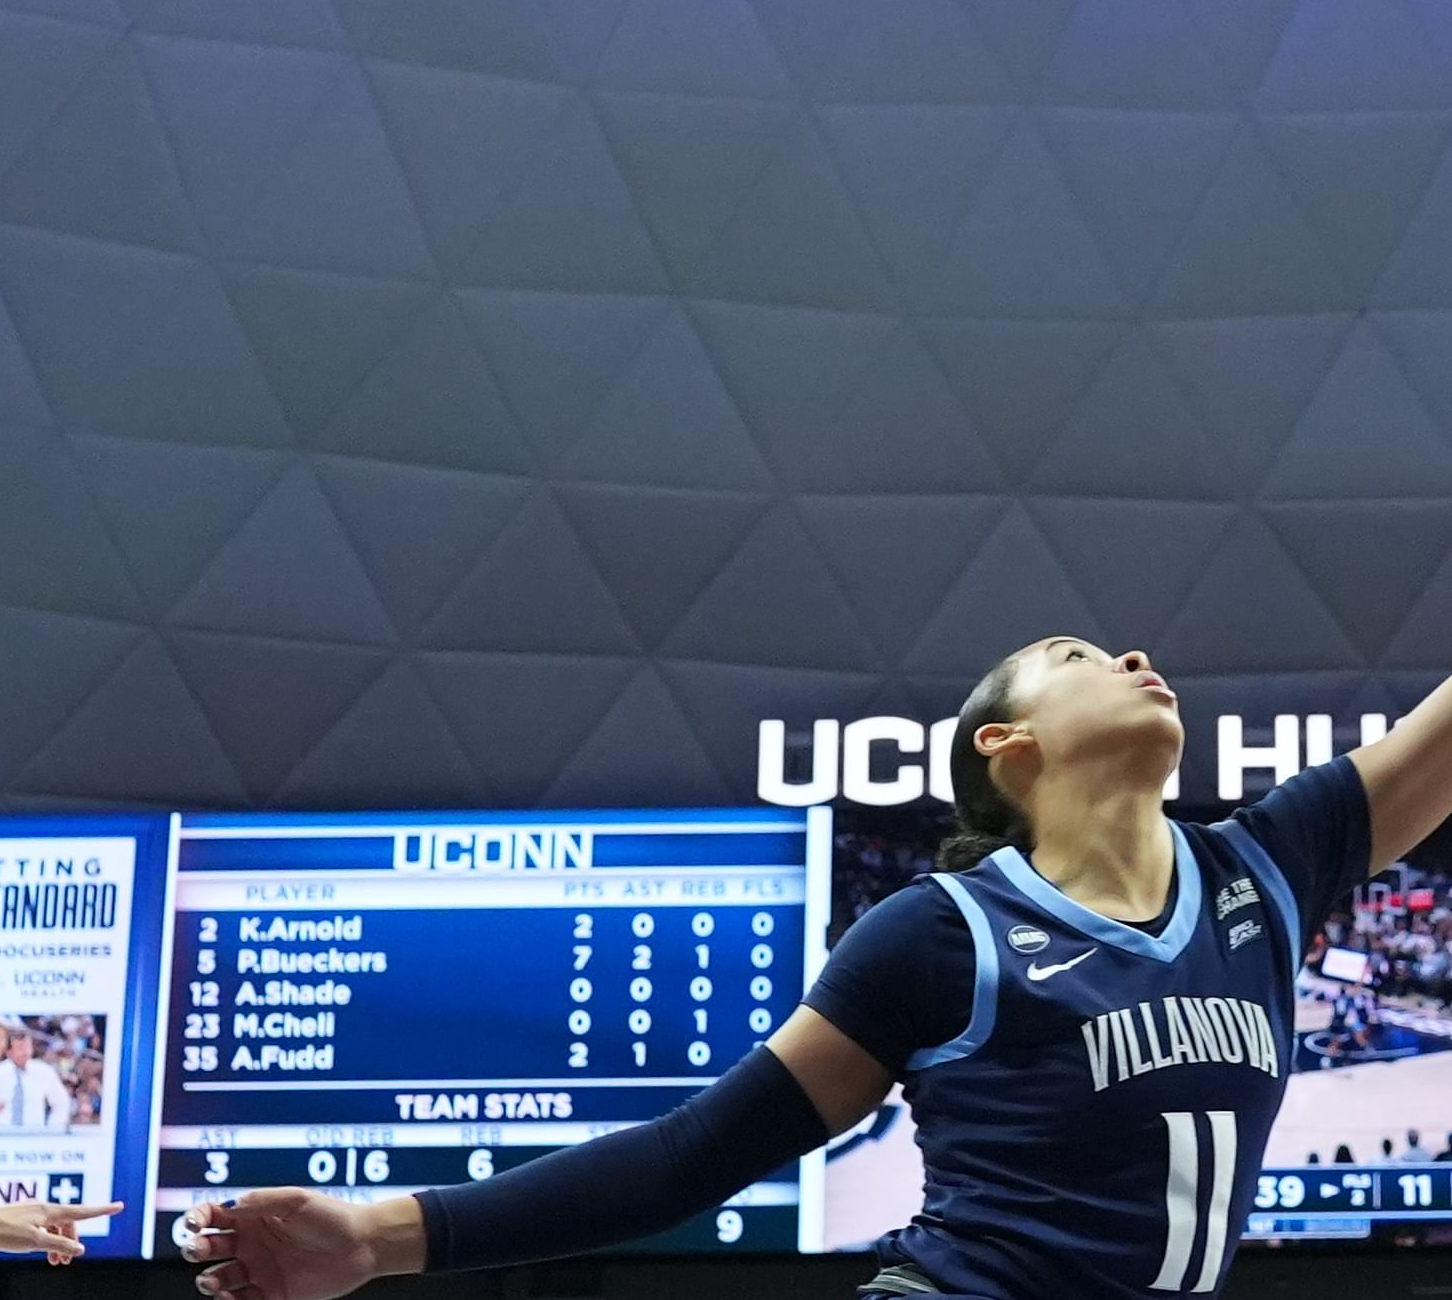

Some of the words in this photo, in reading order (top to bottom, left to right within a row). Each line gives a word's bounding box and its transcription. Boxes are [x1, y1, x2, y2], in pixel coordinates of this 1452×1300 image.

[392, 830, 595, 871] UCONN
[246, 883, 336, 902] PLAYER
[564, 879, 604, 897] PTS
[623, 879, 666, 897] AST
[681, 878, 727, 895] REB
[743, 877, 784, 894] FLS
[198, 917, 219, 943] 2
[238, 915, 363, 942] K.Arnold
[573, 913, 594, 939] 2
[631, 912, 655, 938] 0
[691, 912, 715, 937] 0
[751, 911, 775, 937] 0
[197, 949, 216, 974] 5
[237, 948, 388, 974] P.Bueckers
[572, 945, 593, 971] 7
[631, 944, 653, 970] 2
[694, 944, 710, 969] 1
[750, 943, 774, 969] 0
[14, 970, 85, 986] UCONN
[189, 981, 220, 1007] 12
[234, 980, 352, 1006] A.Shade
[569, 977, 593, 1003] 0
[629, 977, 653, 1002] 0
[689, 976, 713, 1001] 0
[749, 975, 773, 1001] 0
[184, 1013, 221, 1039] 23
[568, 1009, 592, 1035] 0
[628, 1009, 652, 1034] 0
[692, 1008, 708, 1034] 1
[748, 1007, 773, 1033] 0
[183, 1046, 219, 1071] 35
[230, 1044, 335, 1070] A.Fudd
[568, 1042, 589, 1068] 2
[631, 1041, 647, 1067] 1
[687, 1040, 712, 1067] 0
[1080, 996, 1280, 1093] VILLANOVA
[395, 1095, 478, 1119] TEAM
[484, 1092, 573, 1119] STATS
[198, 1128, 238, 1148] AST
[15, 1151, 55, 1164] NOW
[61, 1151, 85, 1163] ON
[204, 1151, 230, 1184] 3
[467, 1148, 495, 1182] 6
[1147, 1111, 1238, 1293] 11
[1254, 1175, 1306, 1208] 39
[1397, 1174, 1433, 1207] 11
[716, 1209, 744, 1243] 9
